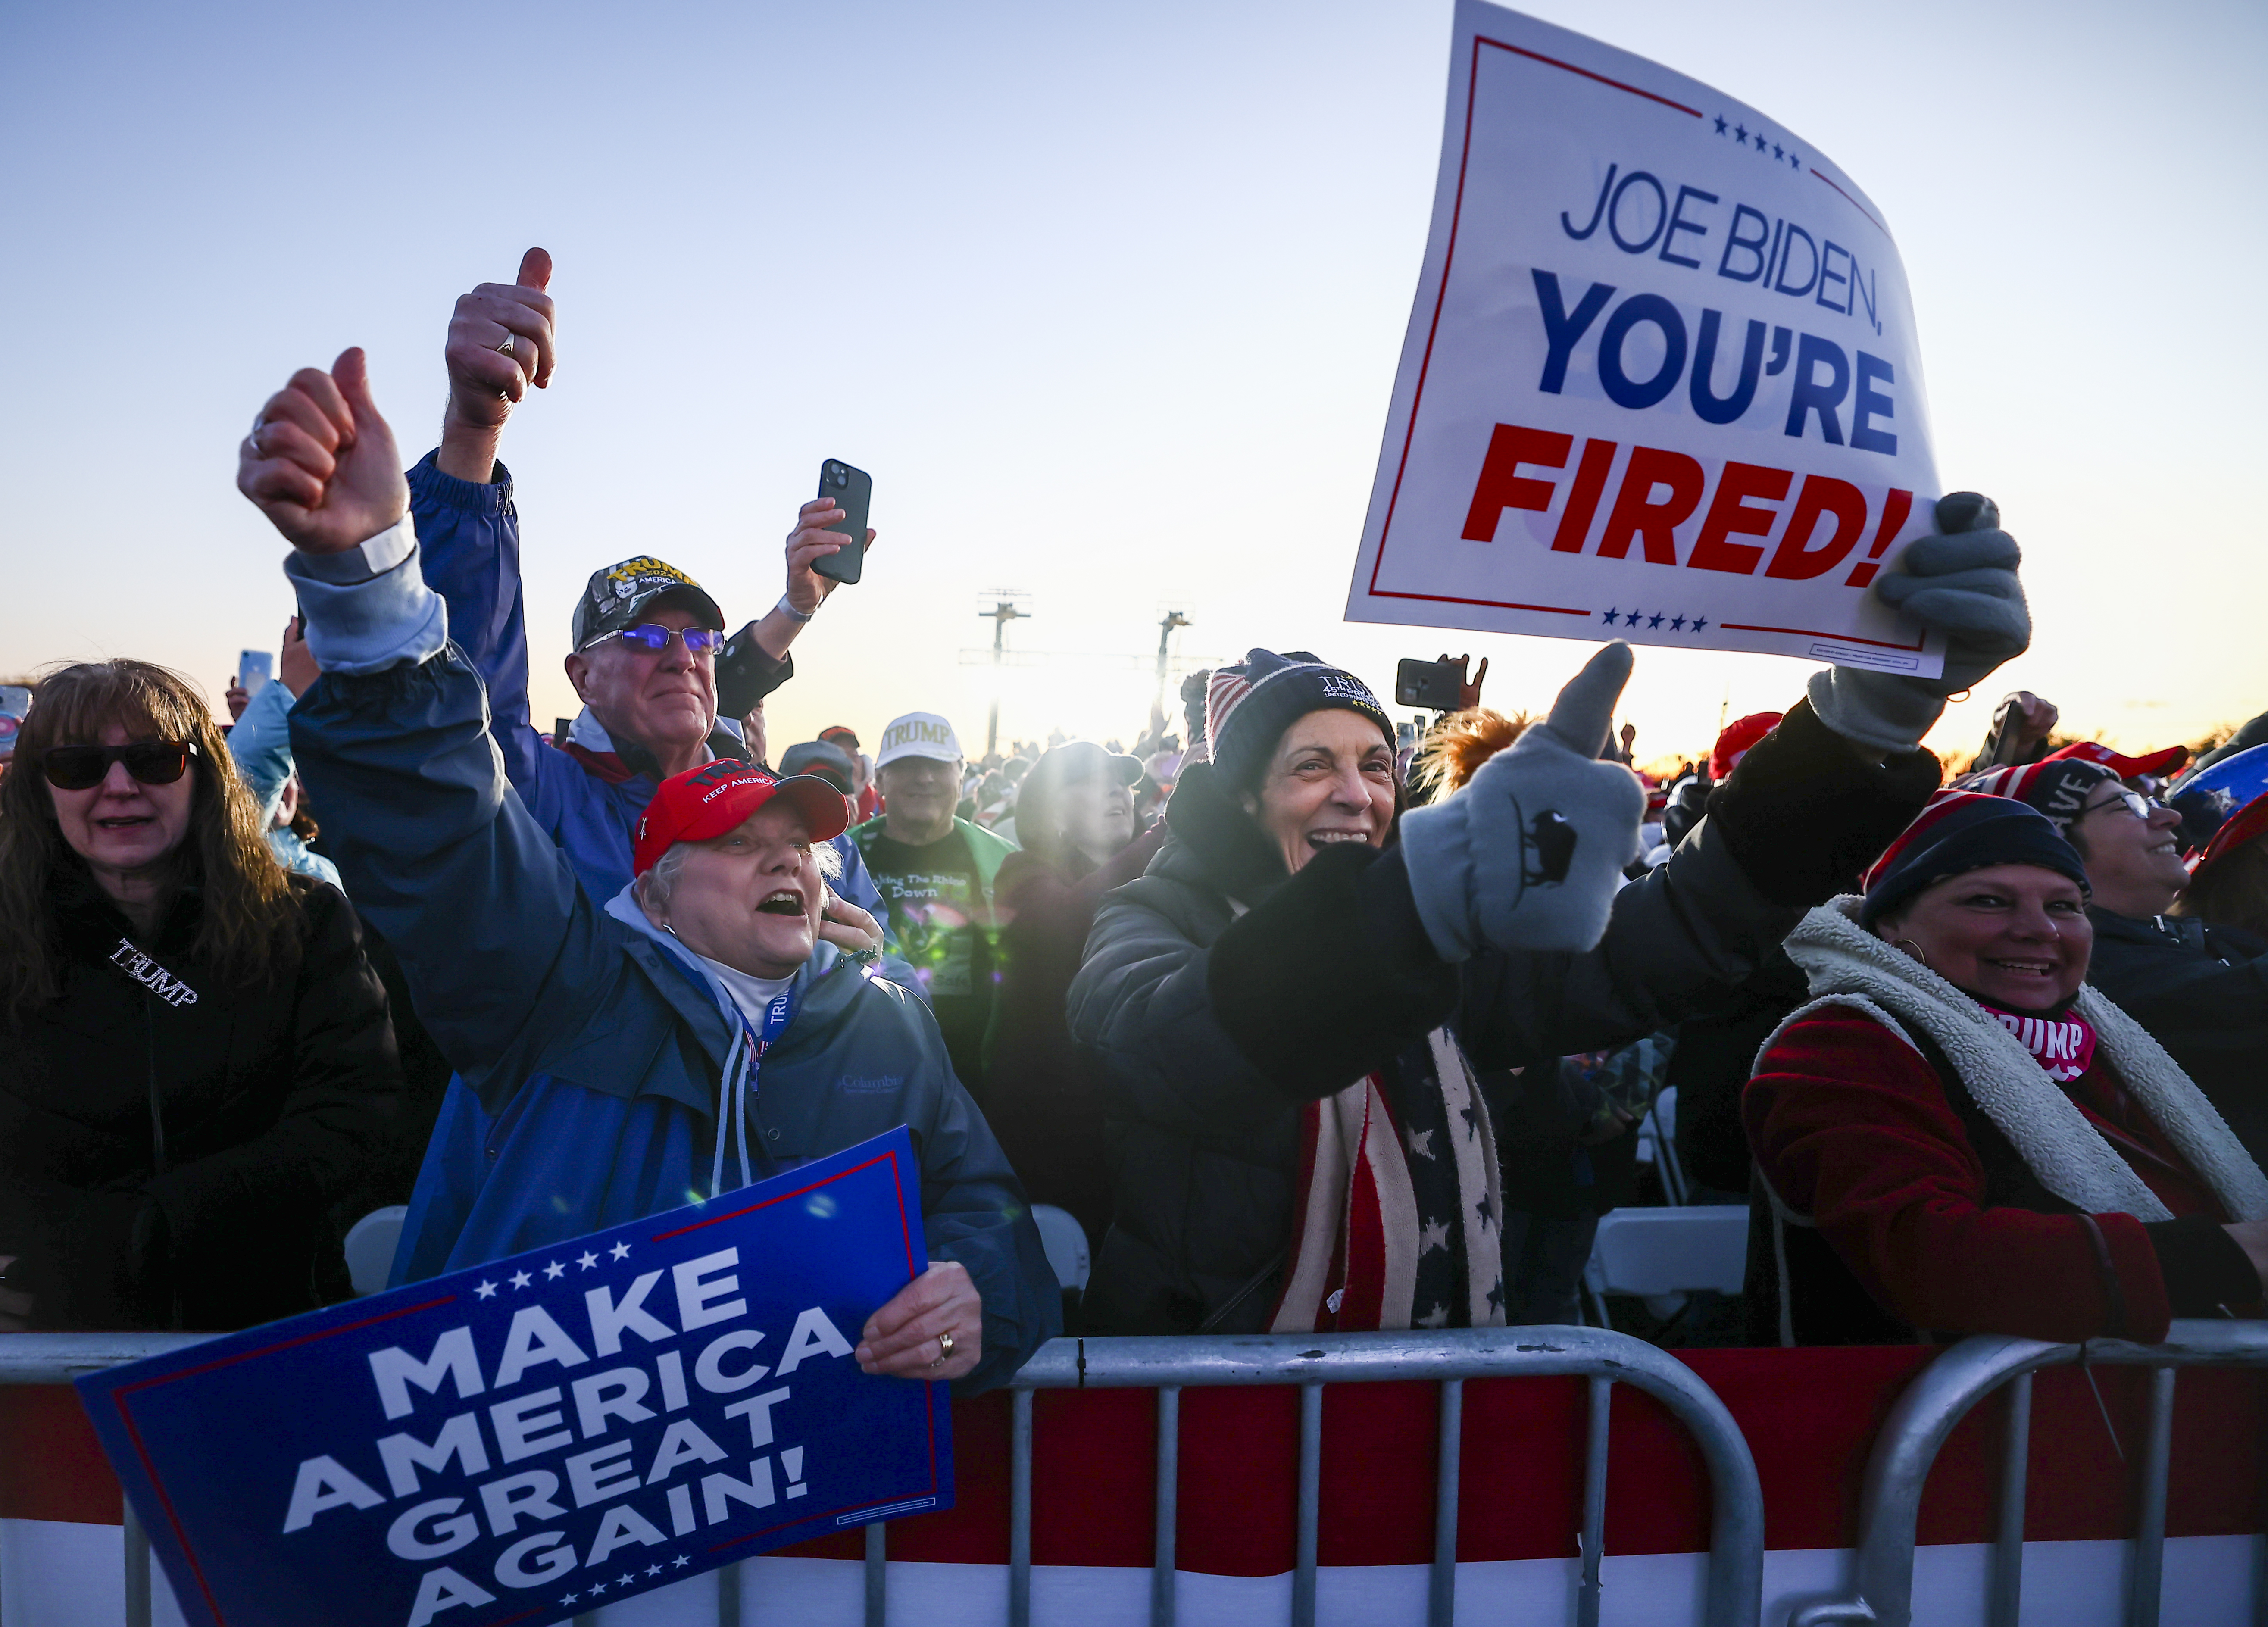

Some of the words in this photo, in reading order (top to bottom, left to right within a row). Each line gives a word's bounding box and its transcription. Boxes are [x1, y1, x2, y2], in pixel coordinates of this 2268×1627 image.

[1559, 163, 1721, 268] JOE
[1717, 201, 1884, 336] BIDEN,
[1530, 267, 1898, 457] YOU'RE
[1460, 422, 1914, 589] FIRED!
[638, 575, 677, 584] AMERICA
[702, 784, 728, 803] KEEP
[731, 777, 774, 787] AMERICA
[886, 720, 950, 750] TRUMP
[2042, 773, 2096, 839] AVE
[891, 886, 938, 898] Down
[109, 938, 198, 1007] TRUMP
[1997, 1014, 2083, 1060] RUMP
[369, 1246, 747, 1420] MAKE
[283, 1306, 855, 1534] AMERICA
[386, 1386, 793, 1561] GREAT
[407, 1446, 808, 1627] AGAIN!
